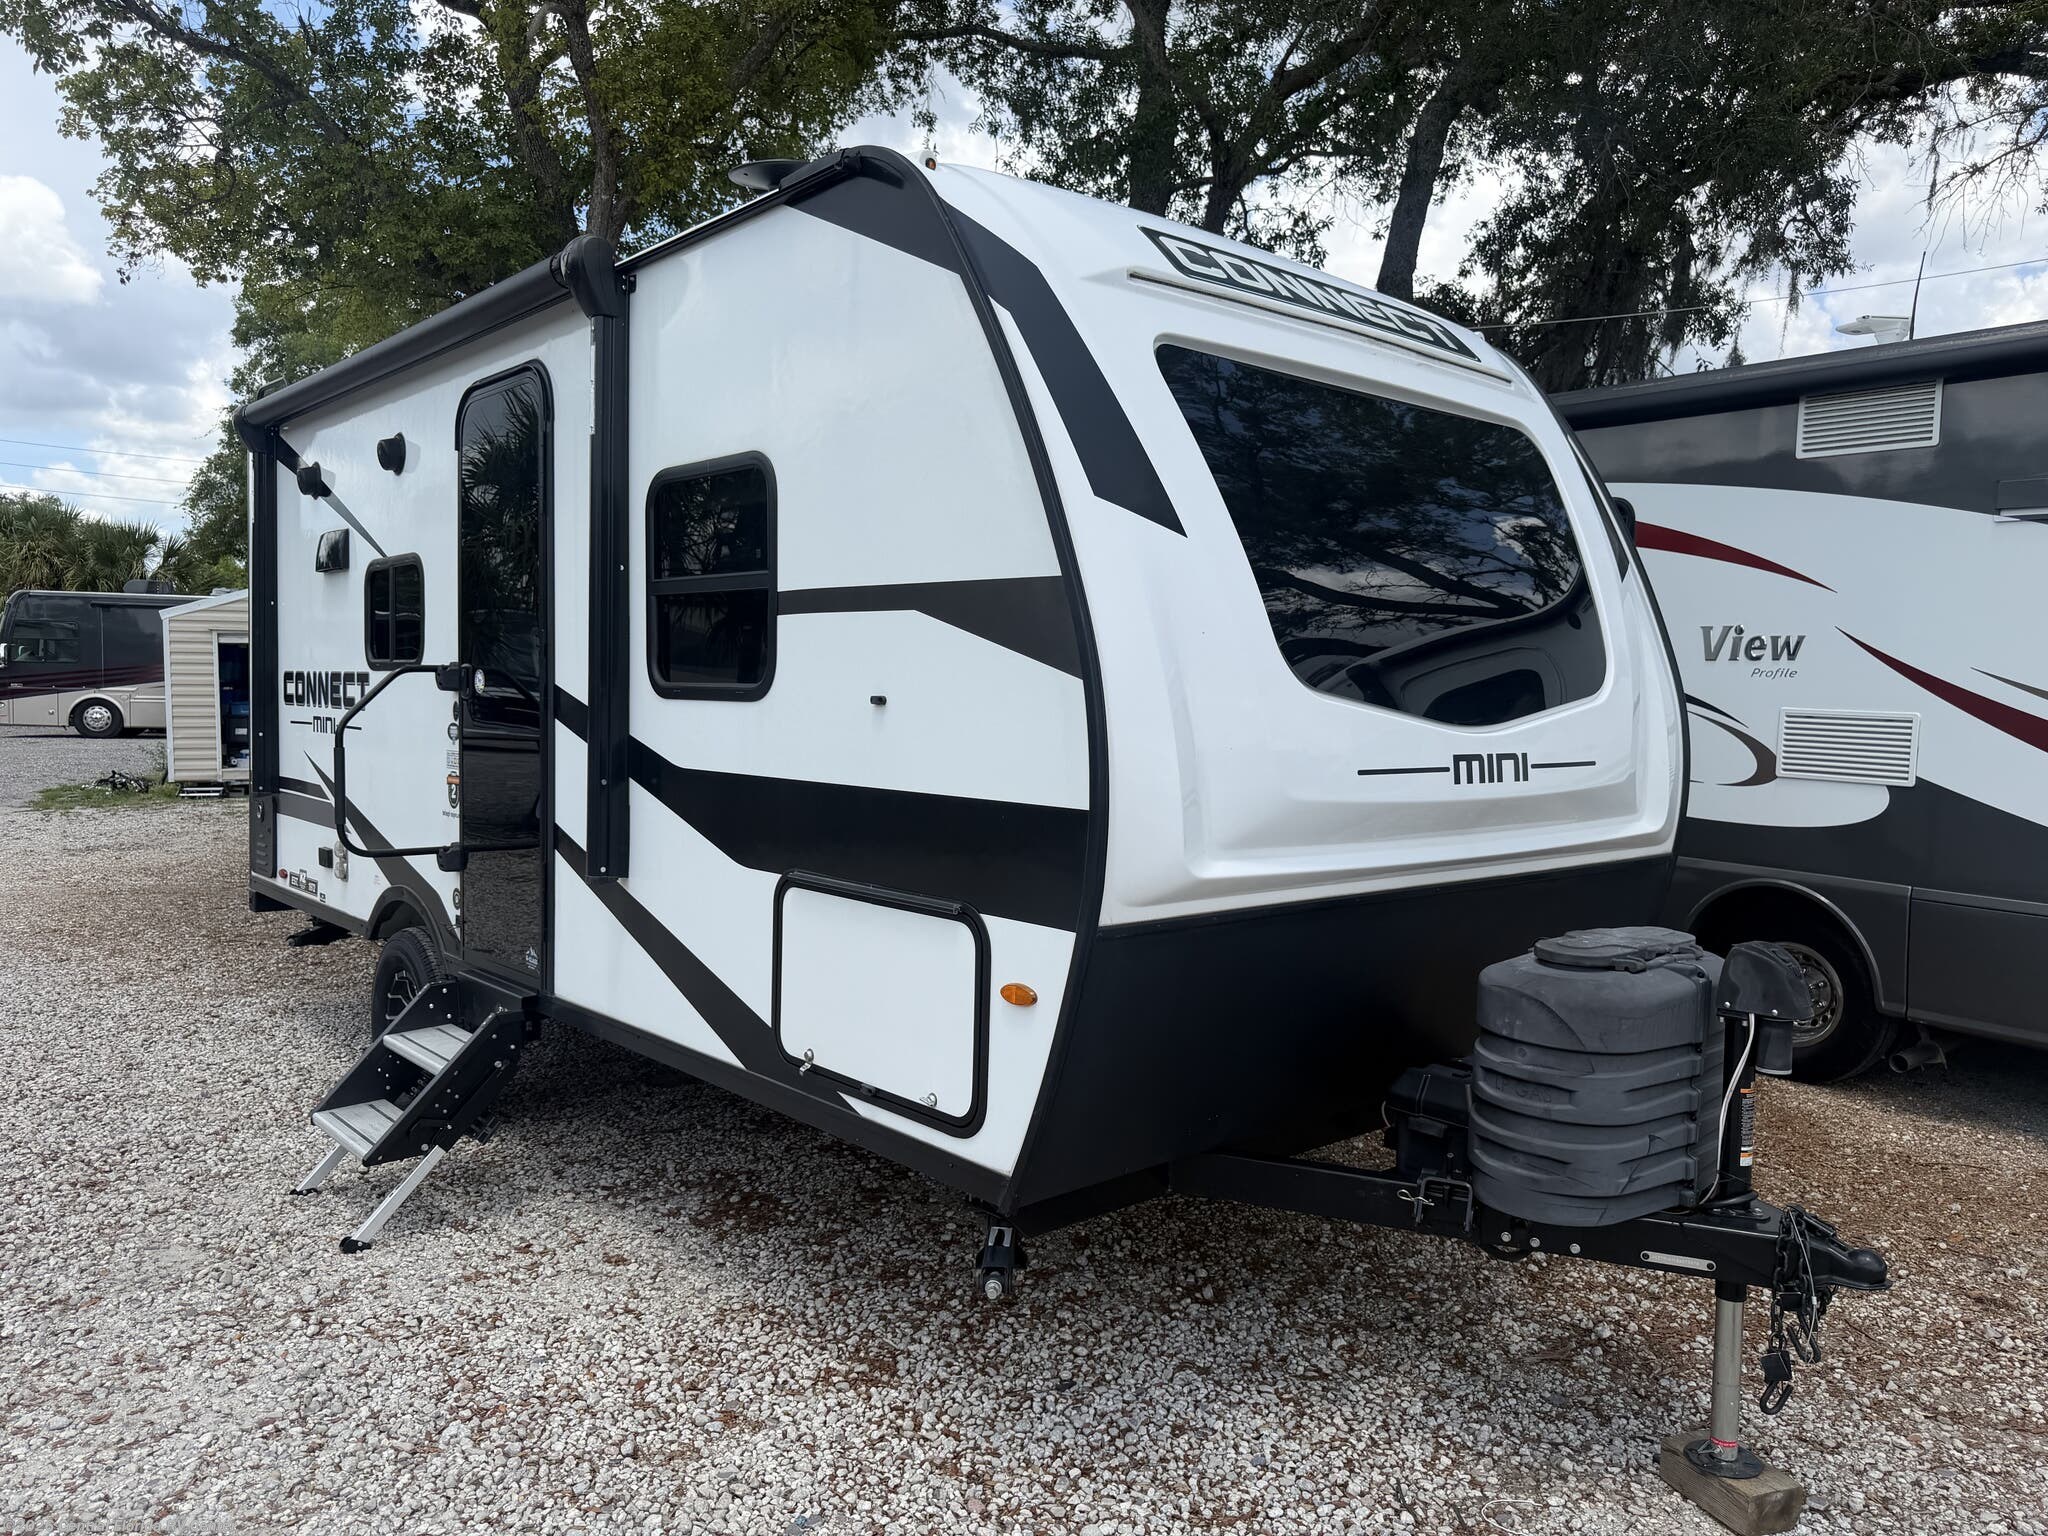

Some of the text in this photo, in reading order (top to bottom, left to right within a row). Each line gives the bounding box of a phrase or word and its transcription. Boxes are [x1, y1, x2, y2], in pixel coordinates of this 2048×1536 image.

[1158, 235, 1459, 351] CONNECT
[1700, 624, 1806, 662] View
[284, 671, 370, 711] CONNECT
[1751, 667, 1798, 680] Profile
